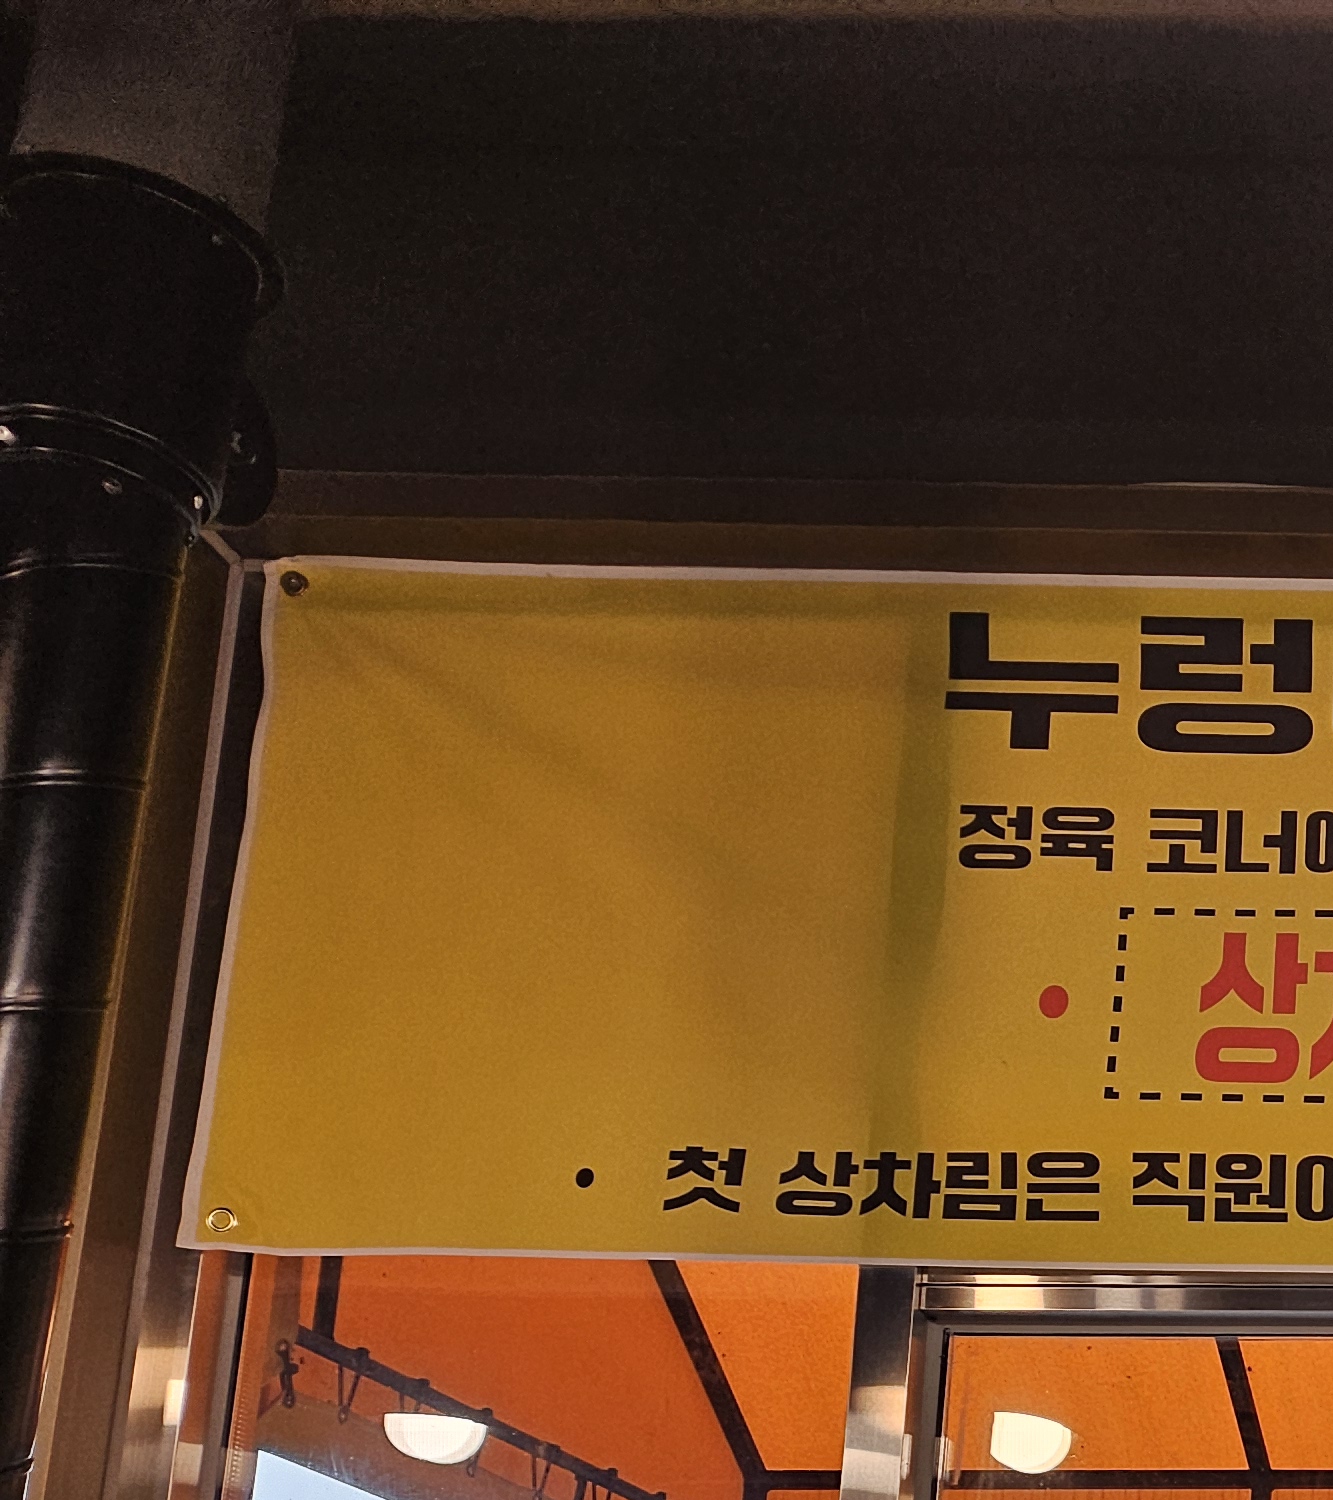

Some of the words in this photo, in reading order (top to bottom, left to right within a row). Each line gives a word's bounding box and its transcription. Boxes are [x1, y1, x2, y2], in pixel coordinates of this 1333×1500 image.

[958, 804, 1115, 872] 정육
[662, 1145, 747, 1213] 첫
[775, 1151, 1100, 1222] 상차림은
